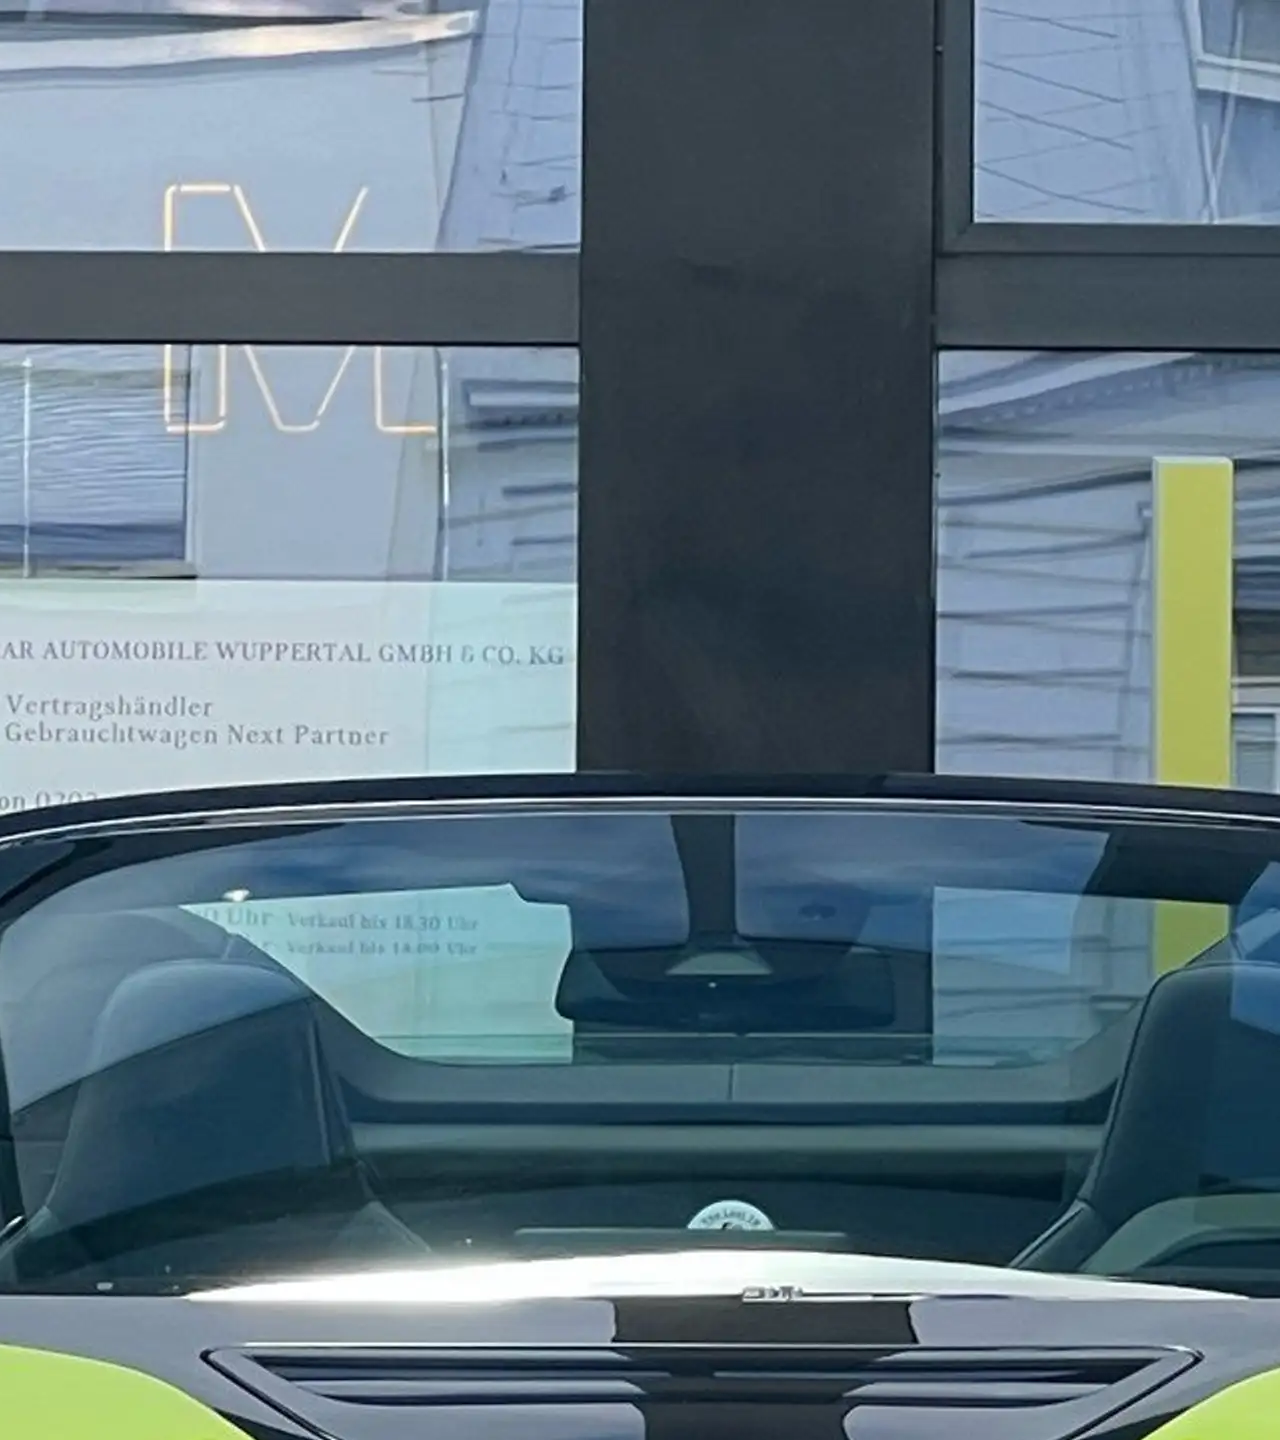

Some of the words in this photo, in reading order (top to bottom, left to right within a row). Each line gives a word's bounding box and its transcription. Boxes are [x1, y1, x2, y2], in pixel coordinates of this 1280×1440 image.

[42, 640, 209, 662] AUTOMOBILE
[216, 641, 371, 663] WUPPERTAL
[378, 642, 452, 663] GMBH
[481, 644, 521, 665] CO.
[529, 645, 565, 666] KG
[7, 694, 214, 722] Vertragshändler
[4, 721, 219, 750] Gebrauchtwagen
[227, 724, 284, 745] Next
[293, 724, 390, 747] Partner
